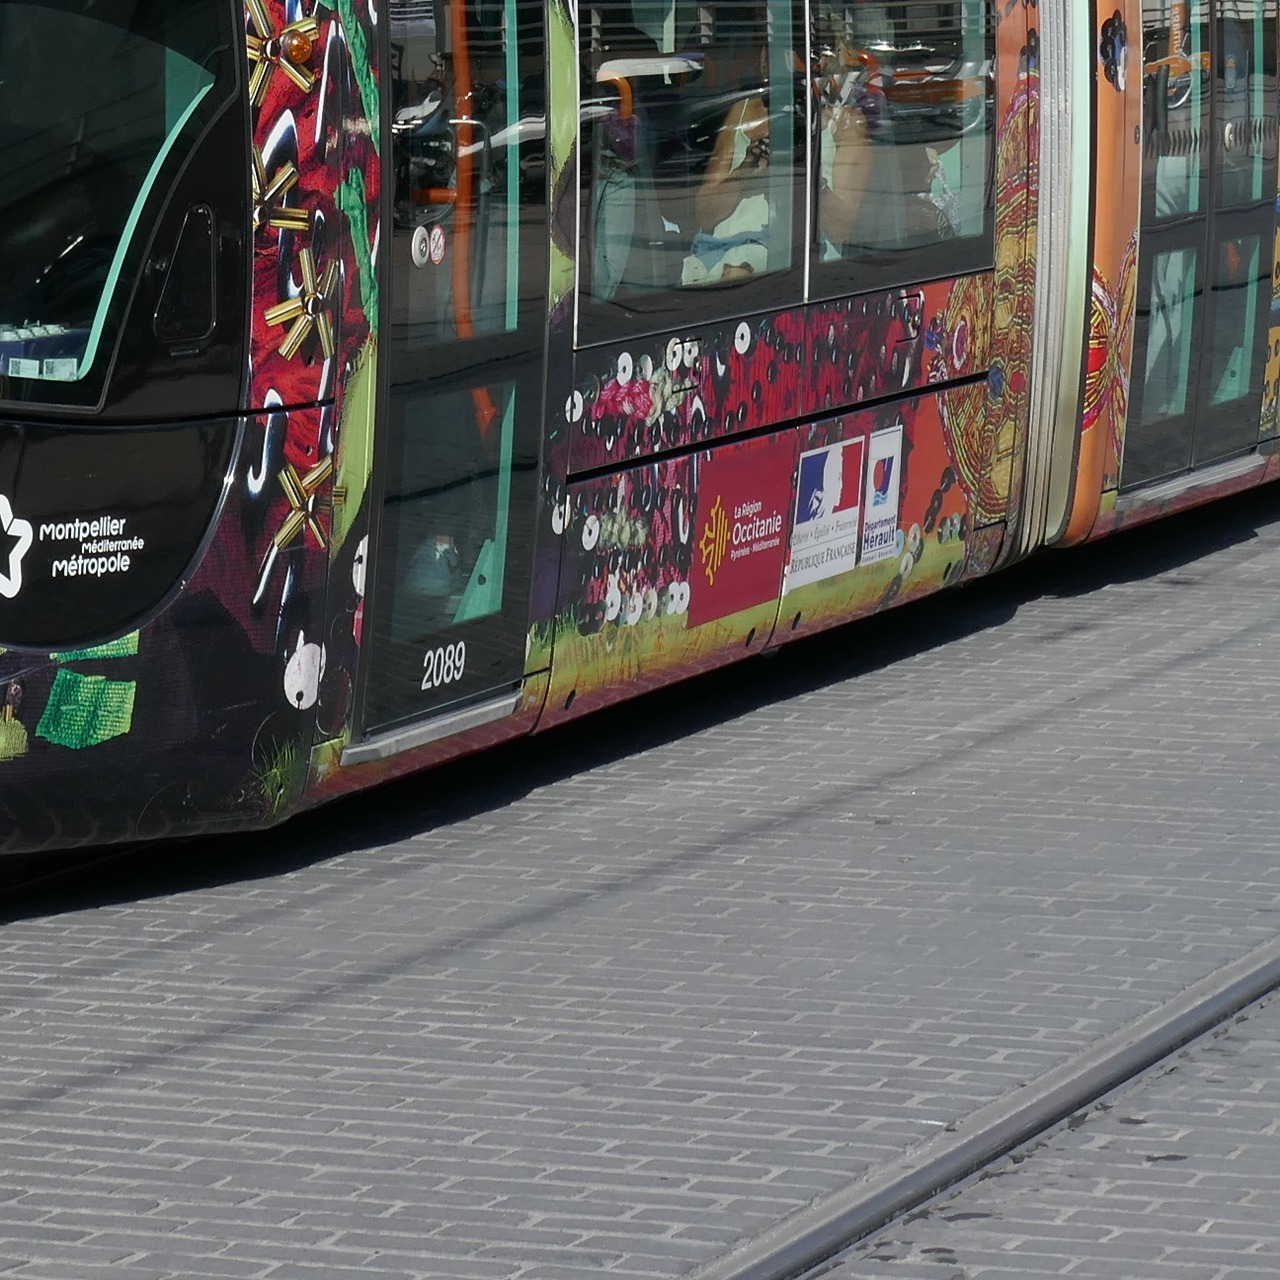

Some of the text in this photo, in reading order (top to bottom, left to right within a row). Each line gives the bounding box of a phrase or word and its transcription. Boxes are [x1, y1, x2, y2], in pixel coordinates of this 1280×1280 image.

[39, 516, 126, 542] Montpellier
[732, 510, 782, 545] Occitanie
[863, 525, 895, 551] Hérault
[81, 536, 144, 554] Méditerranée
[52, 552, 130, 577] Métropole
[421, 640, 466, 691] 2089
